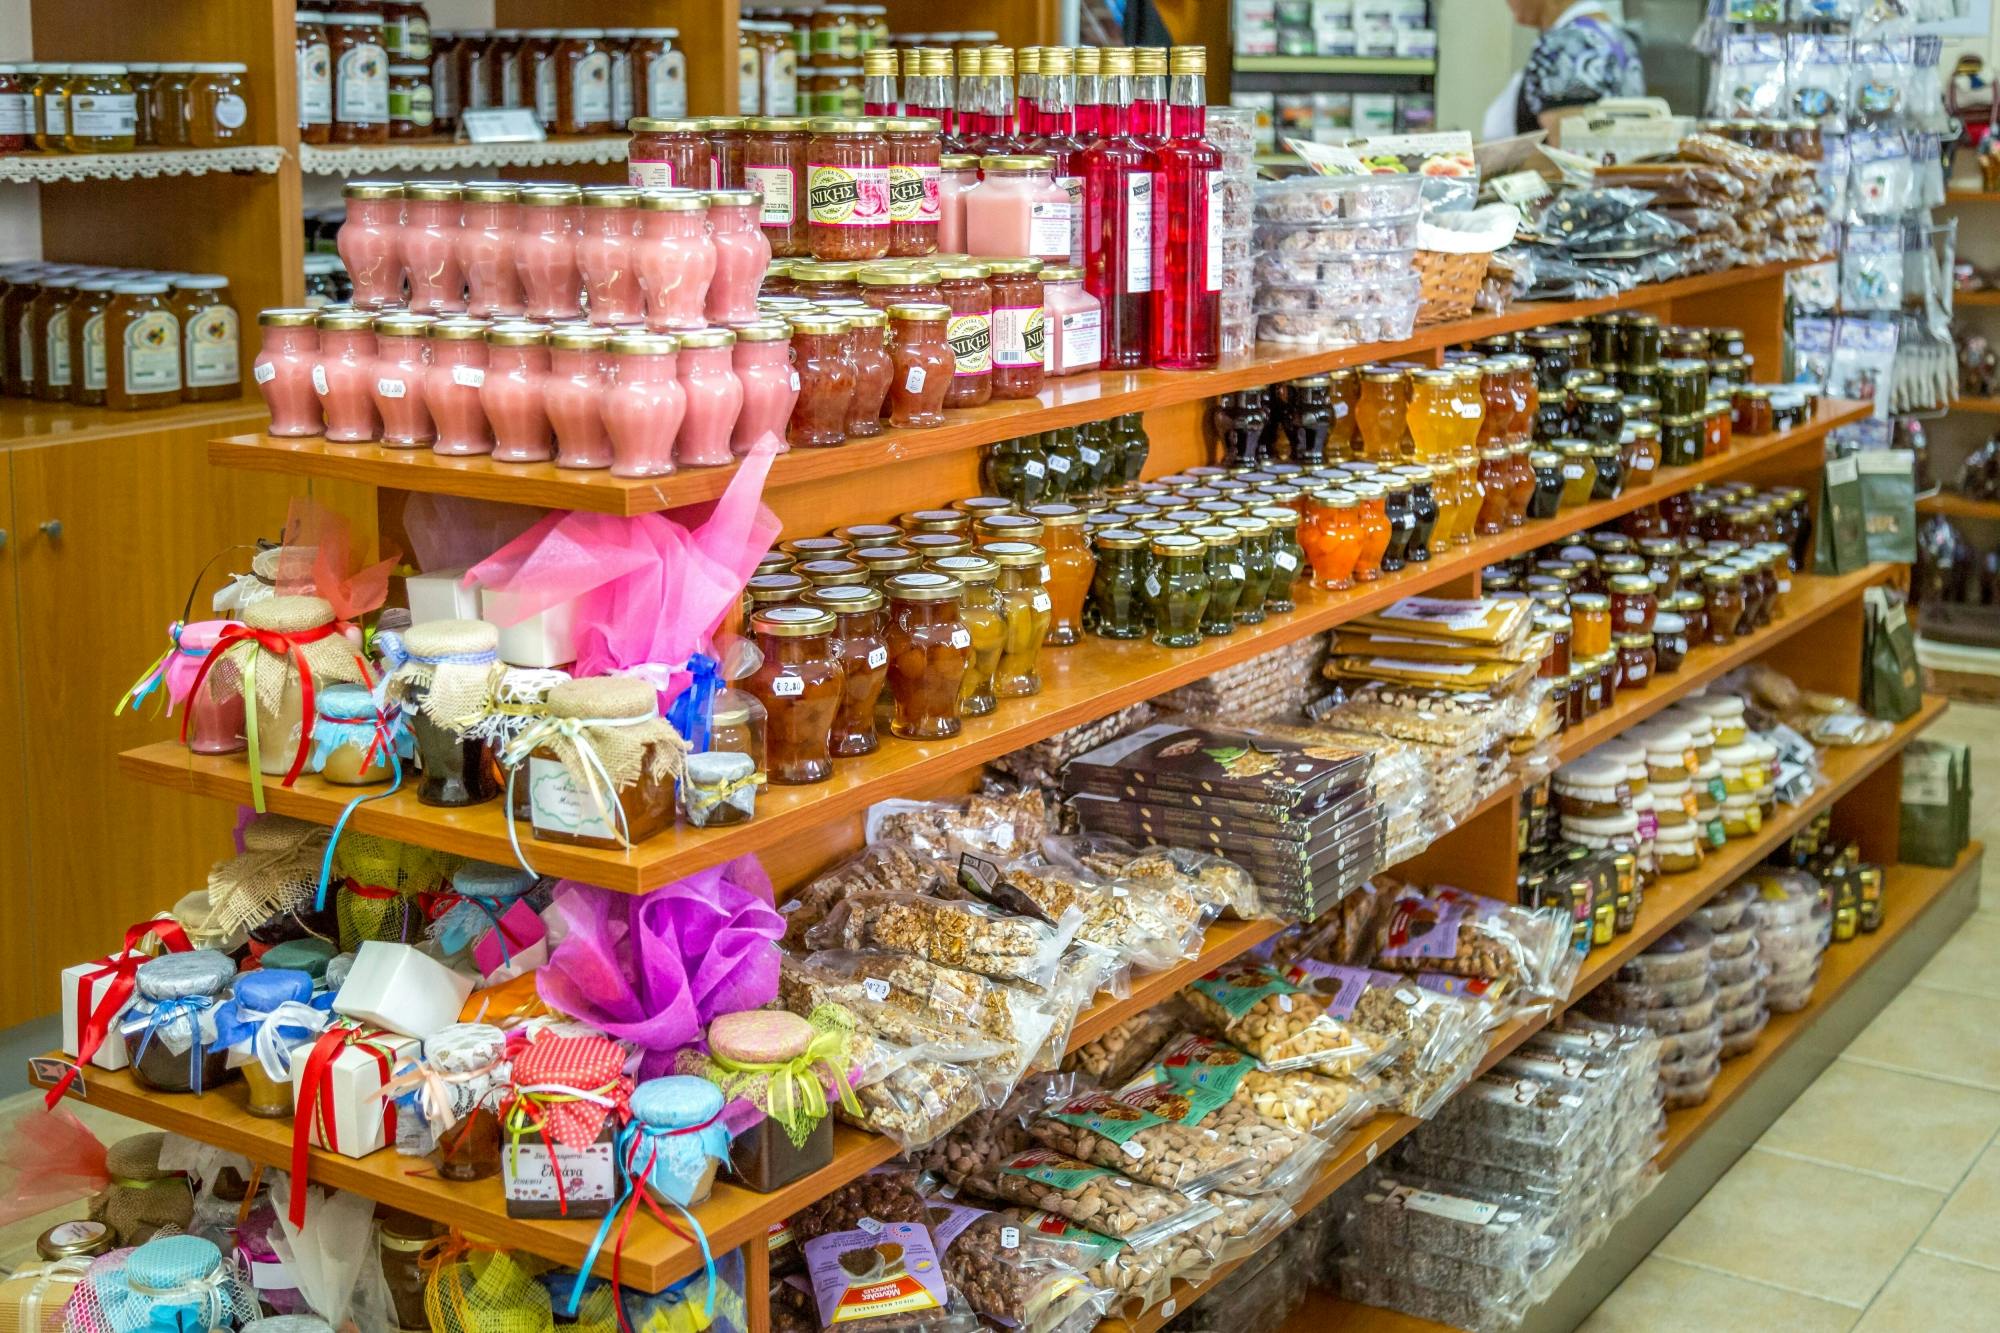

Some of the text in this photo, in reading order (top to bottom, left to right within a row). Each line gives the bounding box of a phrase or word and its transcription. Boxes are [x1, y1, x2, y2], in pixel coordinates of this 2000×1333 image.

[811, 184, 855, 205] ΝΙΚΗΣ
[891, 183, 922, 201] ΚΗΣ
[950, 332, 990, 354] ΝΙΚΗΣ
[541, 1164, 584, 1177] Ελάνα
